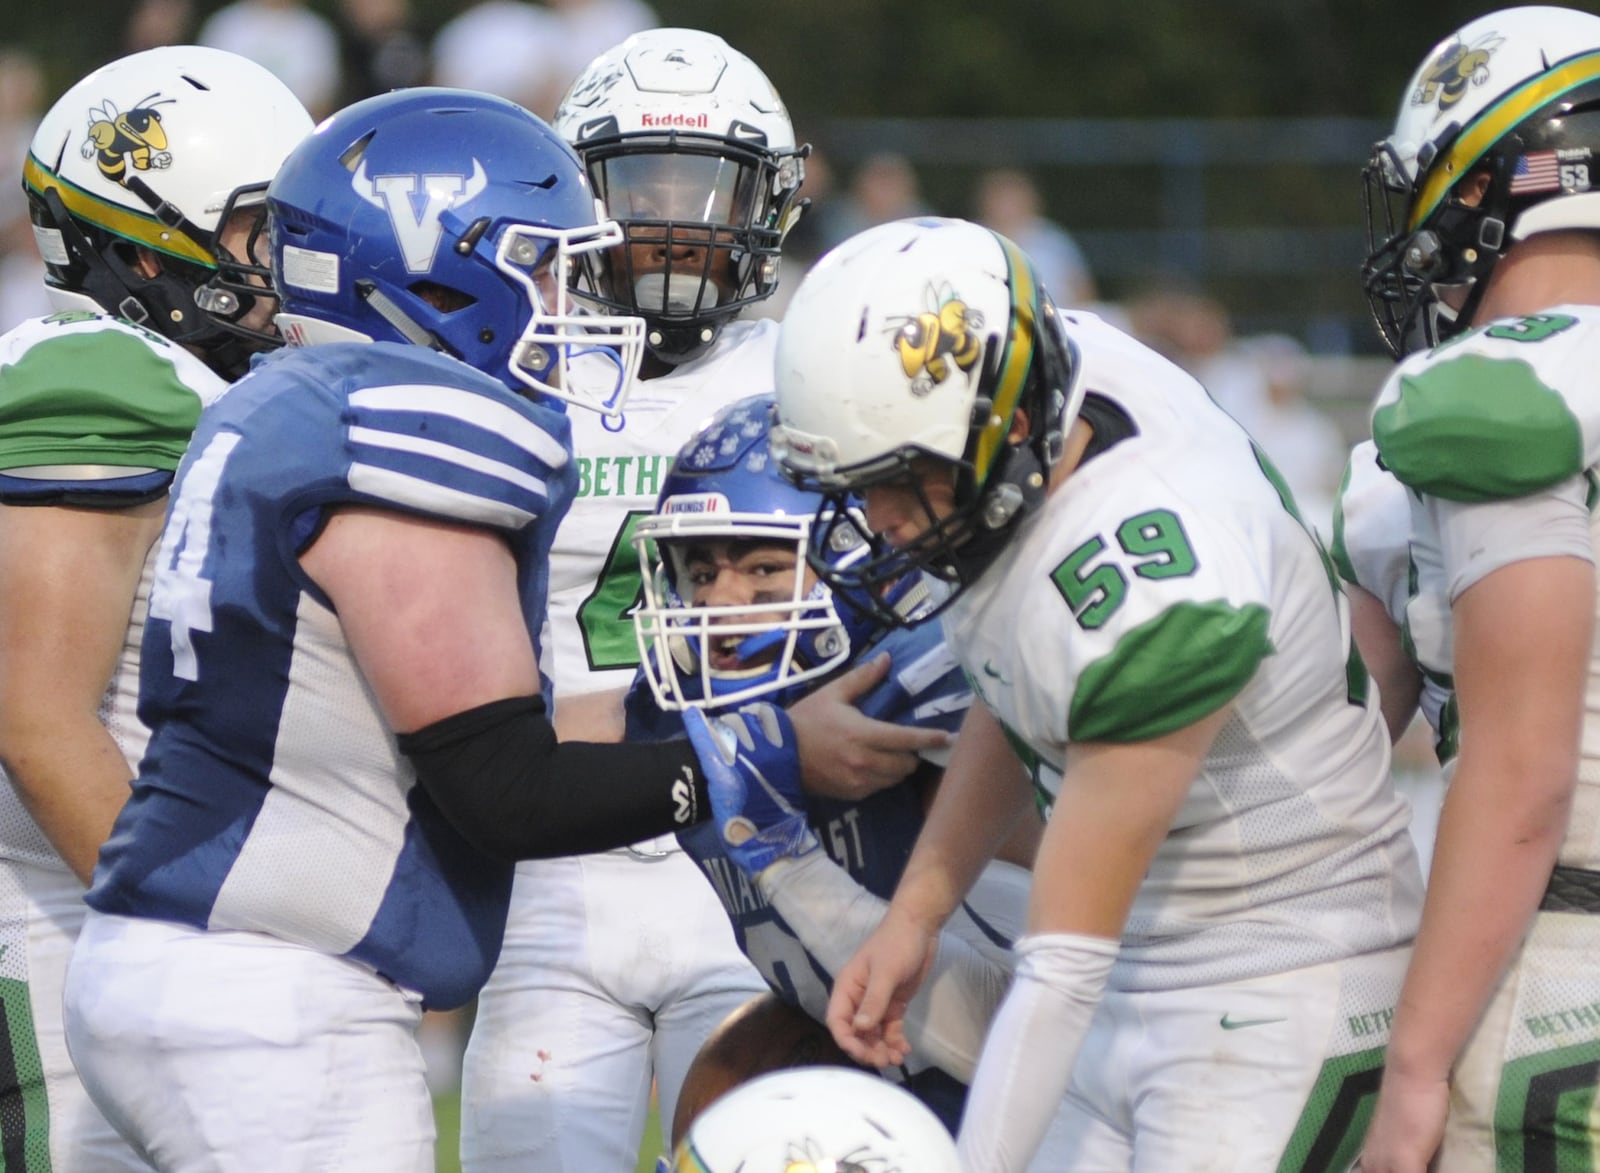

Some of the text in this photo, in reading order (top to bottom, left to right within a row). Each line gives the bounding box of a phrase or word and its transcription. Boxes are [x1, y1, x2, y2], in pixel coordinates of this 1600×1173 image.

[641, 113, 708, 128] Riddell
[1560, 164, 1590, 190] 53
[575, 455, 676, 498] BETH
[670, 500, 705, 514] VIKINGS
[1048, 507, 1201, 632] 59
[1525, 1002, 1600, 1039] BETH
